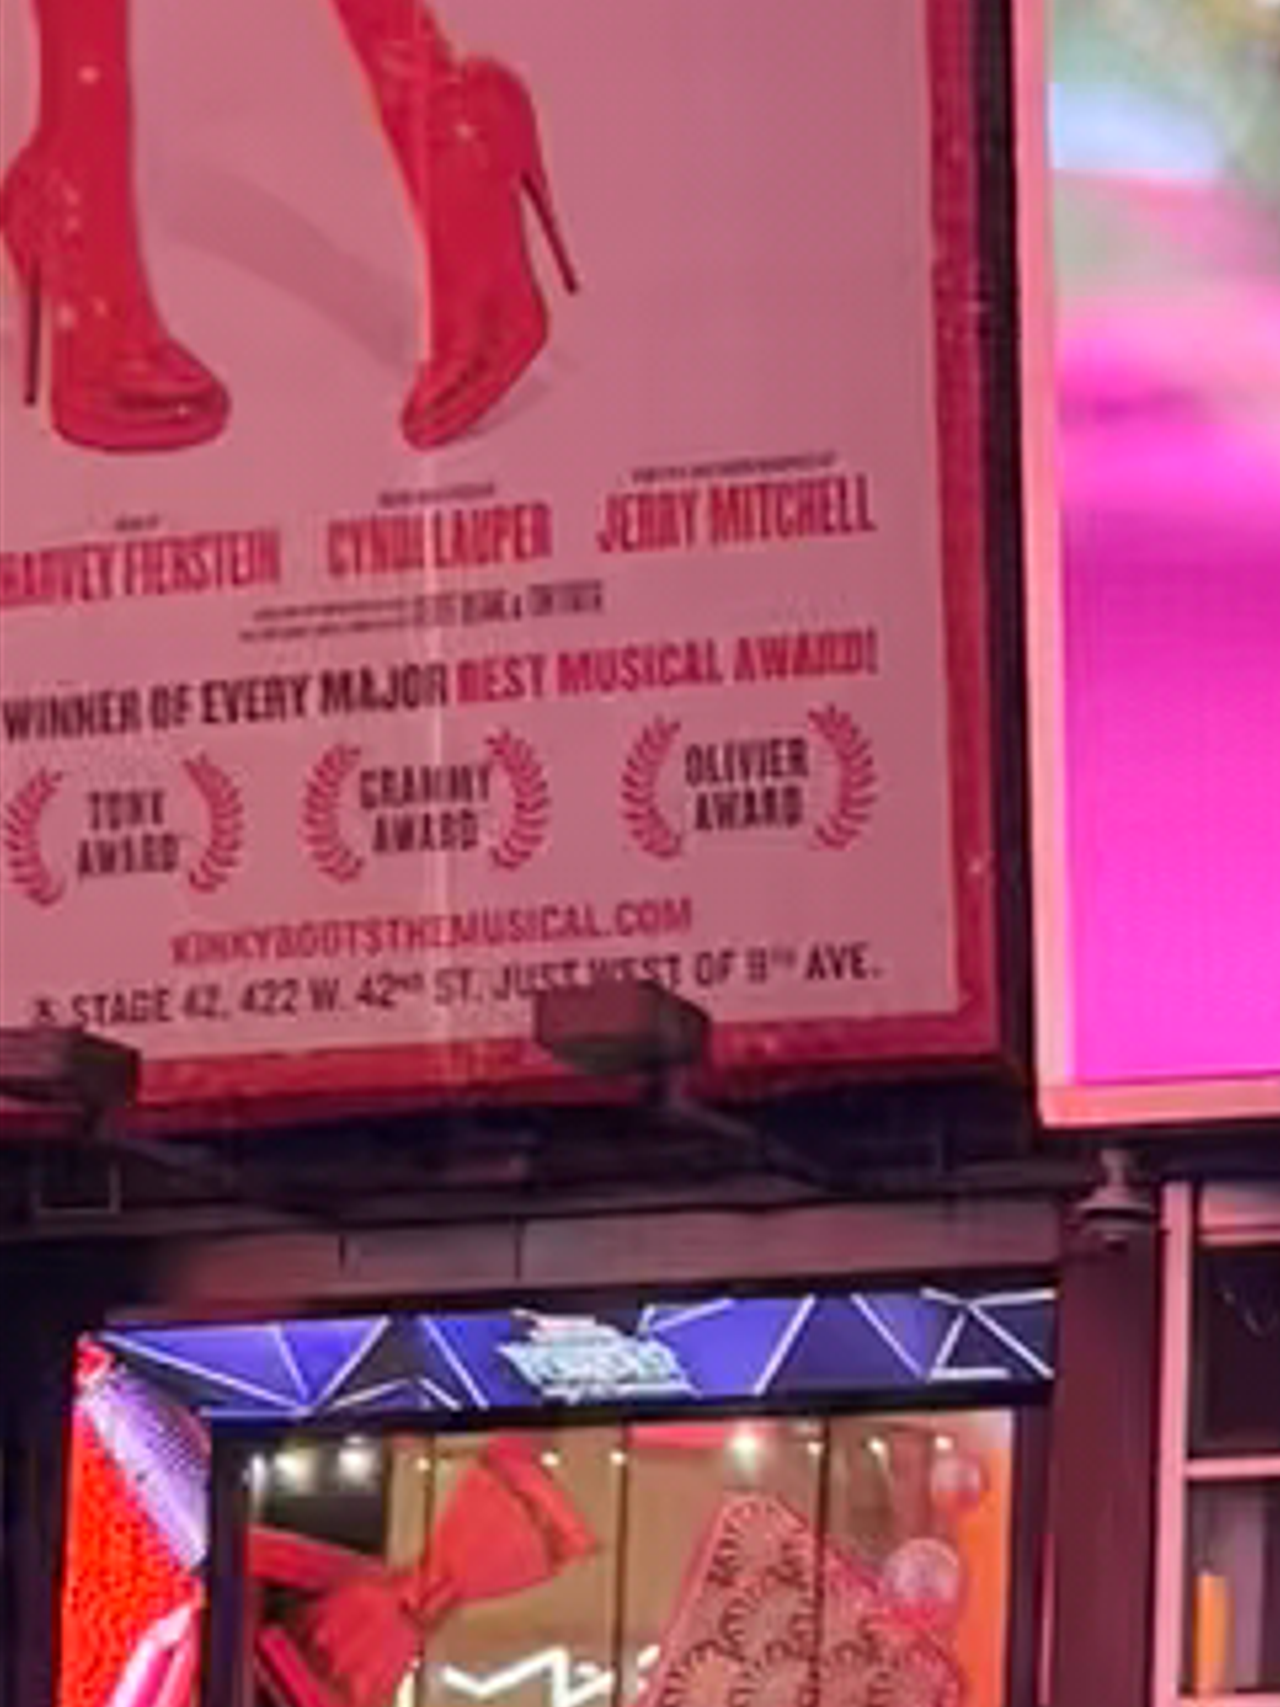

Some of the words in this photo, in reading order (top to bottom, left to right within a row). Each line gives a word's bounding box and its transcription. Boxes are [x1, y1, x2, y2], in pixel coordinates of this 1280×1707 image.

[596, 487, 704, 554] JERRY
[708, 472, 877, 547] MITCHELL
[3, 691, 142, 743] WINNER
[148, 684, 193, 731] OF
[201, 673, 312, 726] EVERY
[320, 662, 450, 715] MAJOR
[456, 653, 547, 705] BEST
[557, 638, 723, 695] MUSICAL
[732, 626, 878, 680] AWARD!
[684, 736, 808, 788] OLIVIER
[370, 808, 479, 854] AWARD
[693, 786, 804, 831] AWARD
[76, 833, 180, 878] AWARD
[72, 989, 172, 1028] STAGE
[239, 979, 299, 1017] 422
[696, 949, 735, 987] OF
